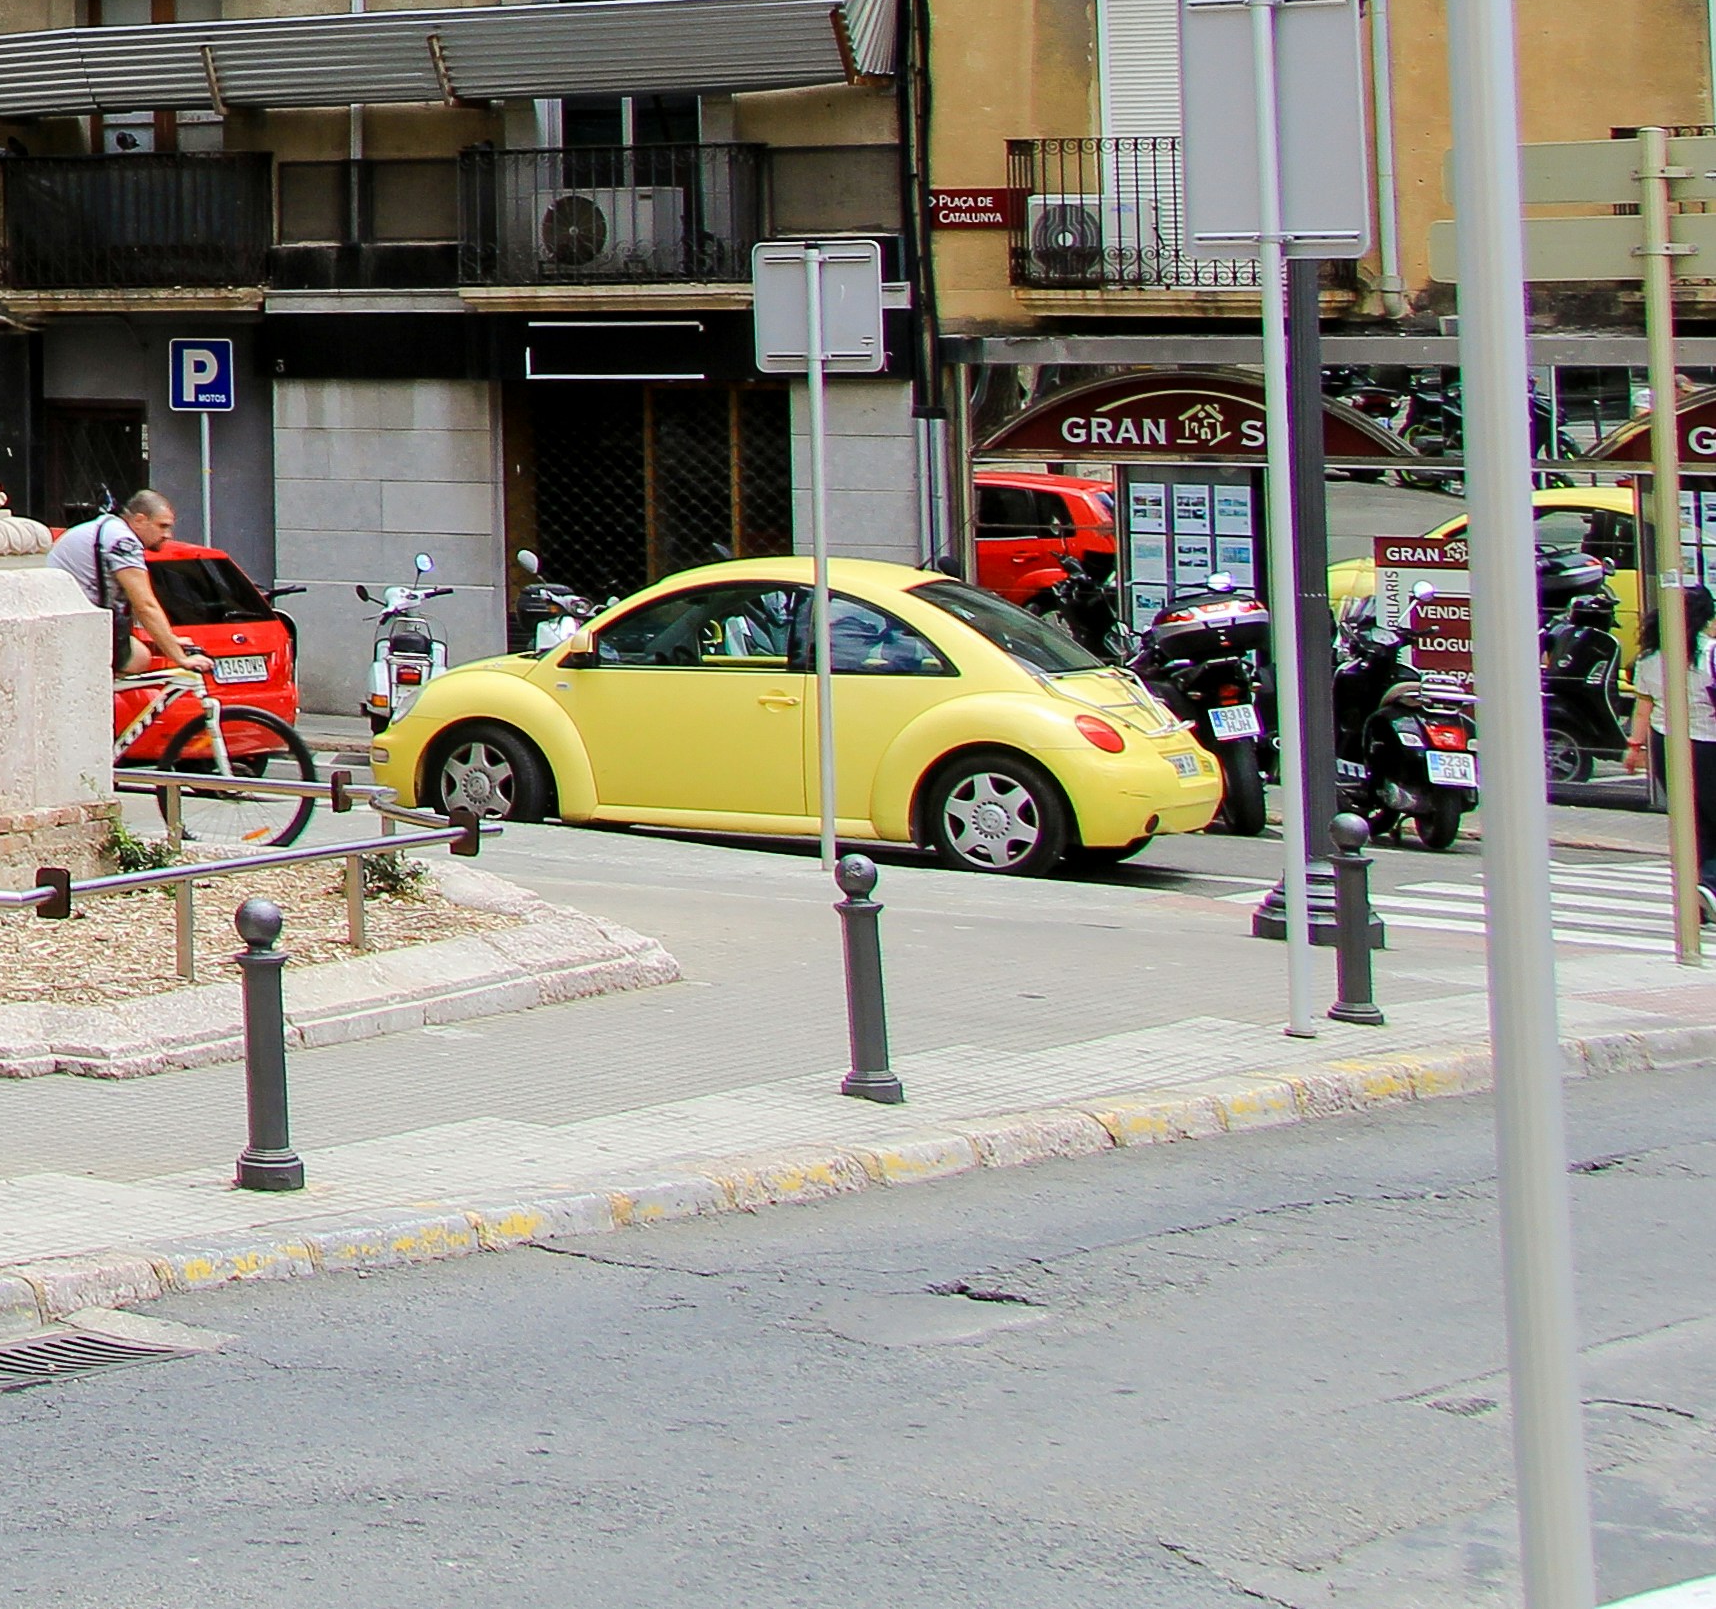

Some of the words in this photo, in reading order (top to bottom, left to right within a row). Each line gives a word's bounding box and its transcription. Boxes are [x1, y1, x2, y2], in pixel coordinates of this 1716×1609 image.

[939, 194, 975, 209] PLAÇA
[977, 196, 994, 207] DE
[939, 210, 1003, 223] CATALUNYA
[183, 349, 218, 402] P
[198, 394, 226, 403] MOTOS
[1061, 417, 1168, 445] GRAN
[1386, 547, 1440, 562] GRAN
[1417, 605, 1472, 620] VENDE
[1418, 638, 1473, 653] LLOGU
[1220, 707, 1252, 721] 9318
[1227, 719, 1252, 733] HJH
[1438, 754, 1470, 768] 5236
